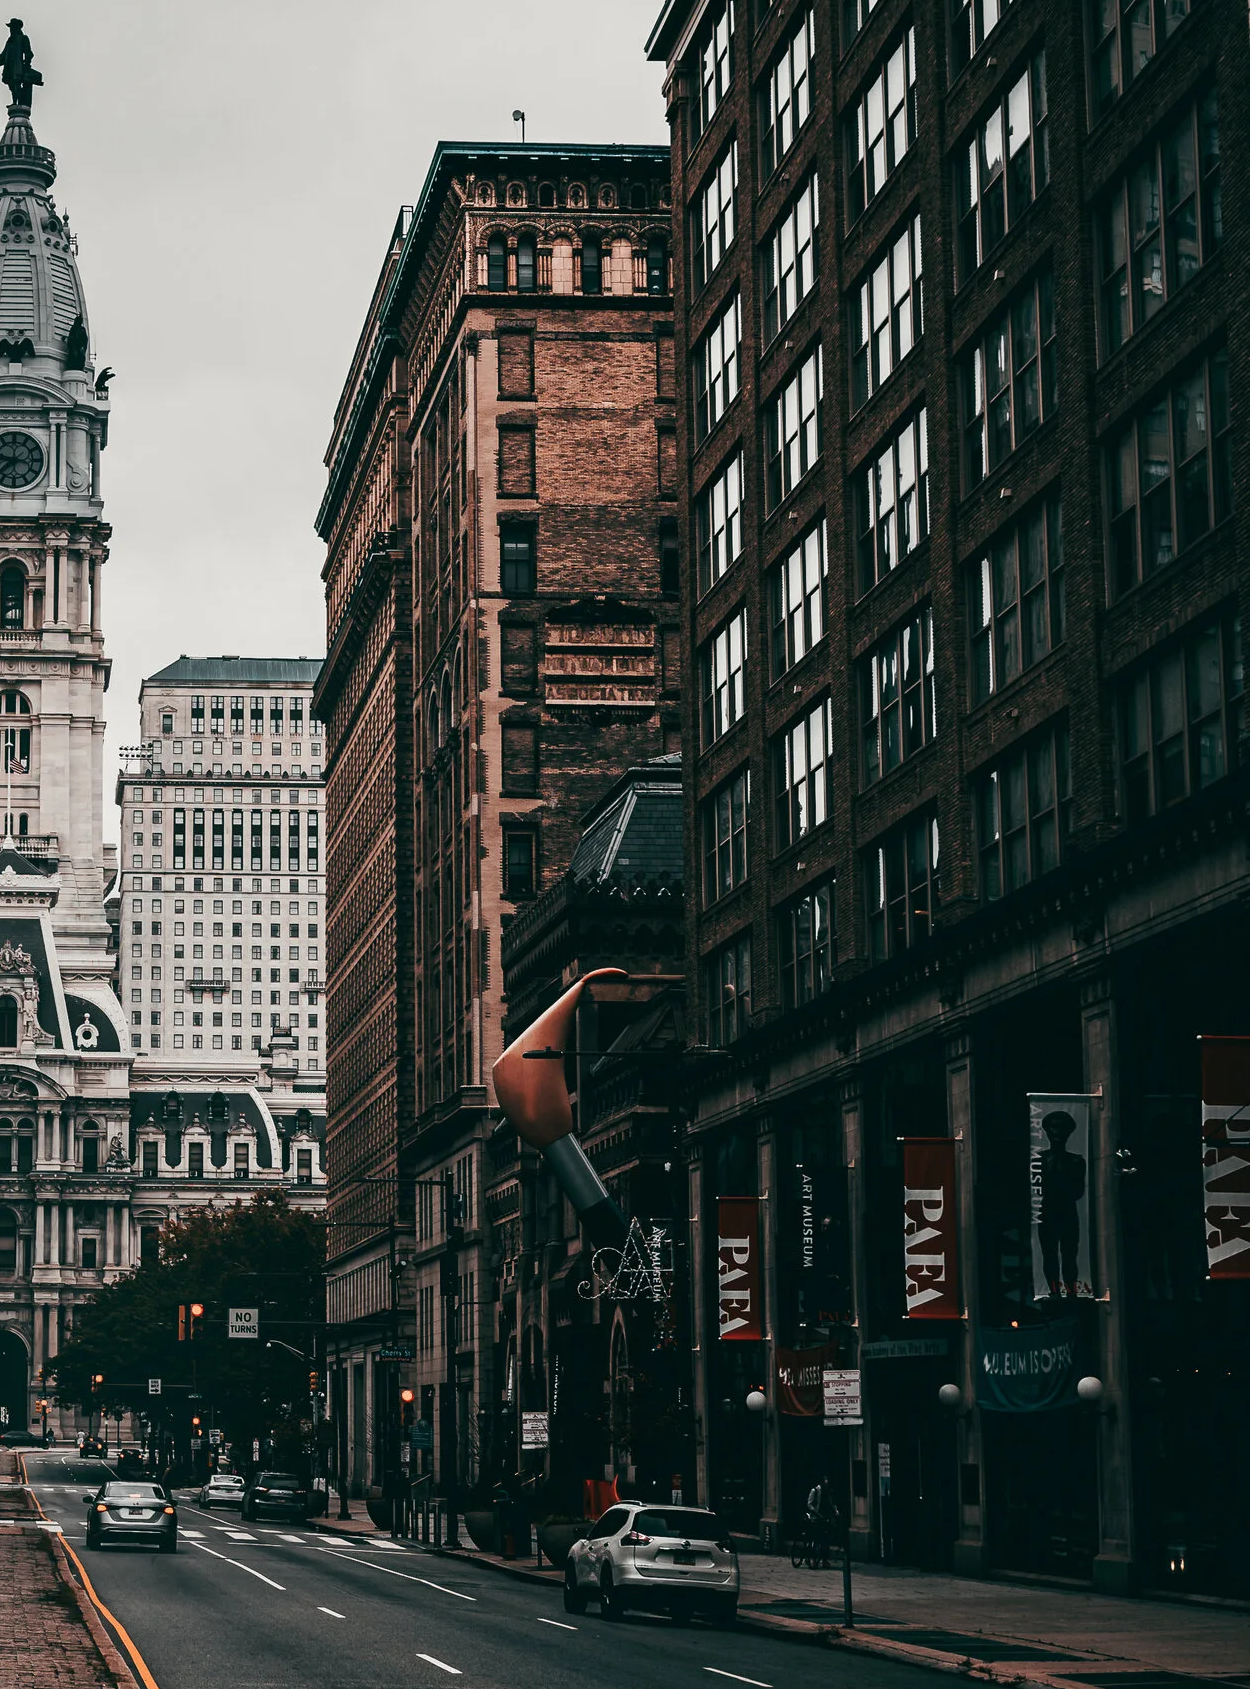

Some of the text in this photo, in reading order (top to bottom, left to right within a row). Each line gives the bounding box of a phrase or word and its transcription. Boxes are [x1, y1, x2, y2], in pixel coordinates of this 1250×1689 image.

[1030, 1105, 1043, 1225] ART MUSEUM
[802, 1174, 813, 1267] ART MUSEUM
[904, 1186, 945, 1311] PAFA
[652, 1252, 661, 1302] MUSEUM
[718, 1235, 750, 1337] PAFA
[230, 1325, 256, 1333] TURNS
[235, 1312, 251, 1322] NO
[1029, 1349, 1039, 1374] IS
